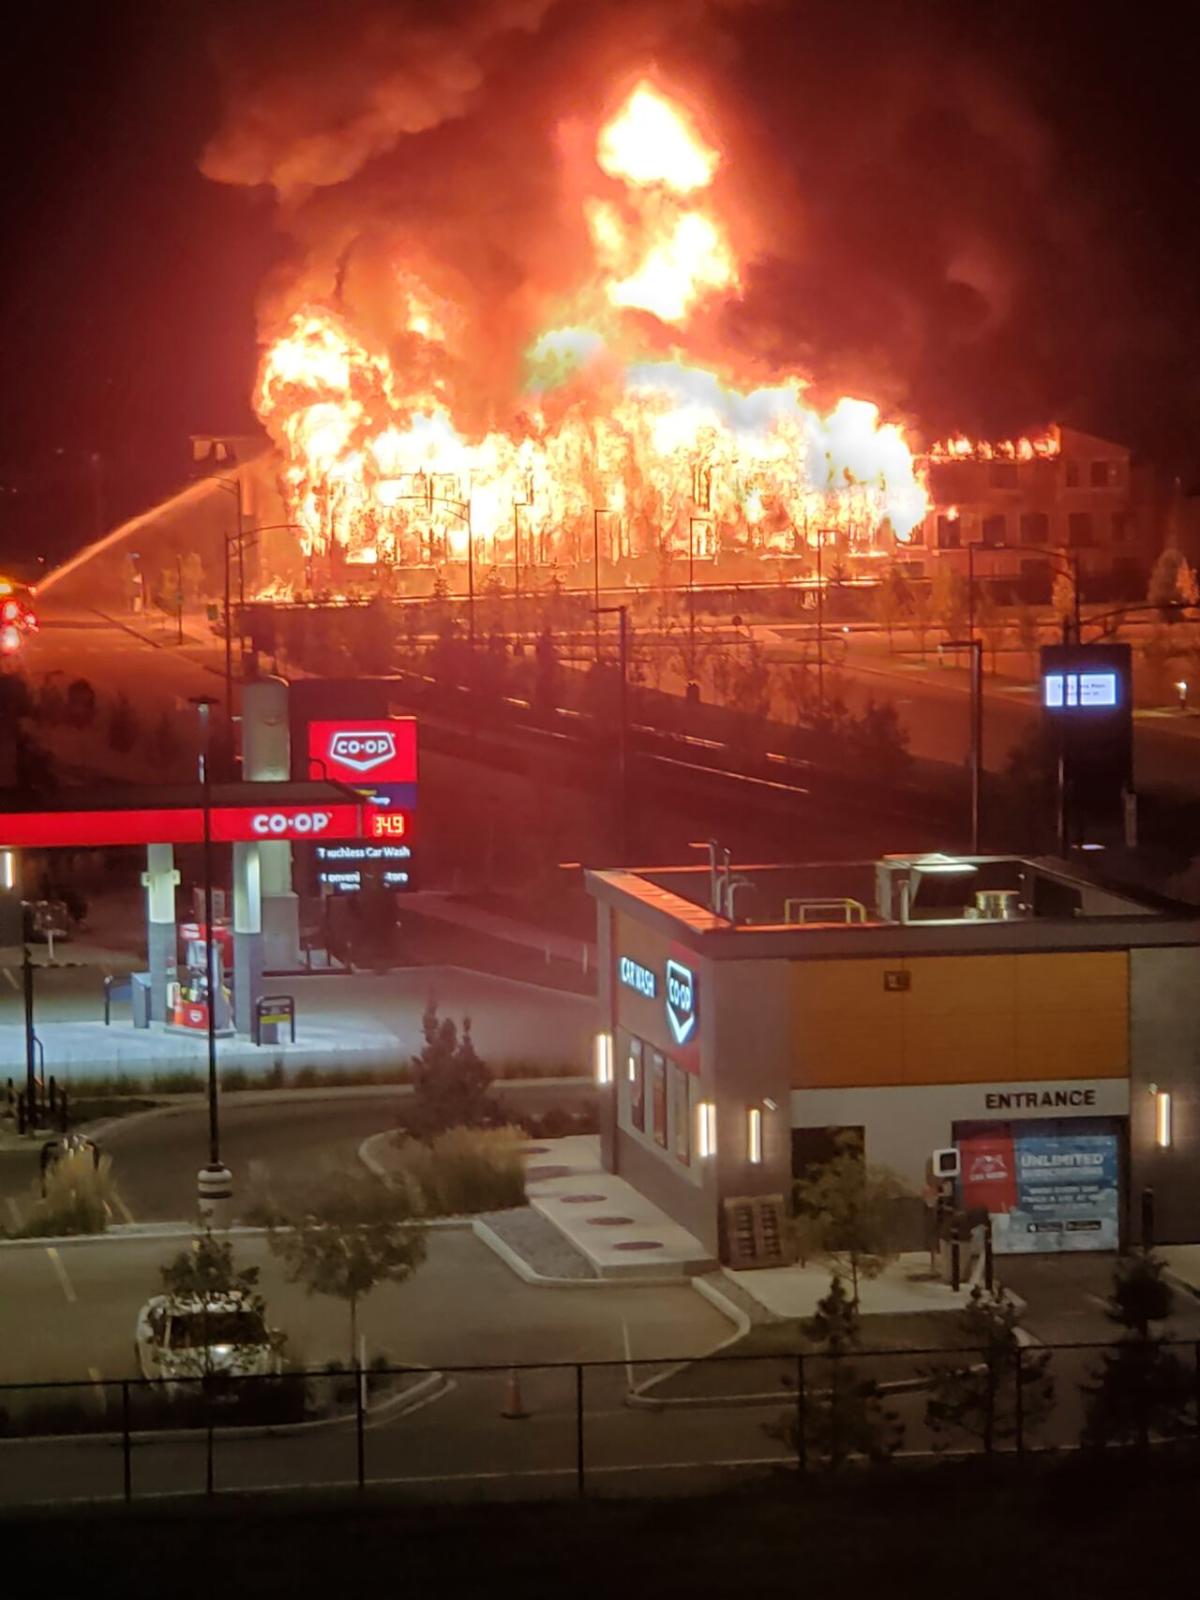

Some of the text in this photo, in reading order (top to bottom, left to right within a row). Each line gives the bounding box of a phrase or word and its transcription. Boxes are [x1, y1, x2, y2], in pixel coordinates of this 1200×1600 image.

[635, 964, 655, 999] WASH
[985, 1089, 1097, 1110] ENTRANCE
[1021, 1153, 1104, 1167] UNLIMITED
